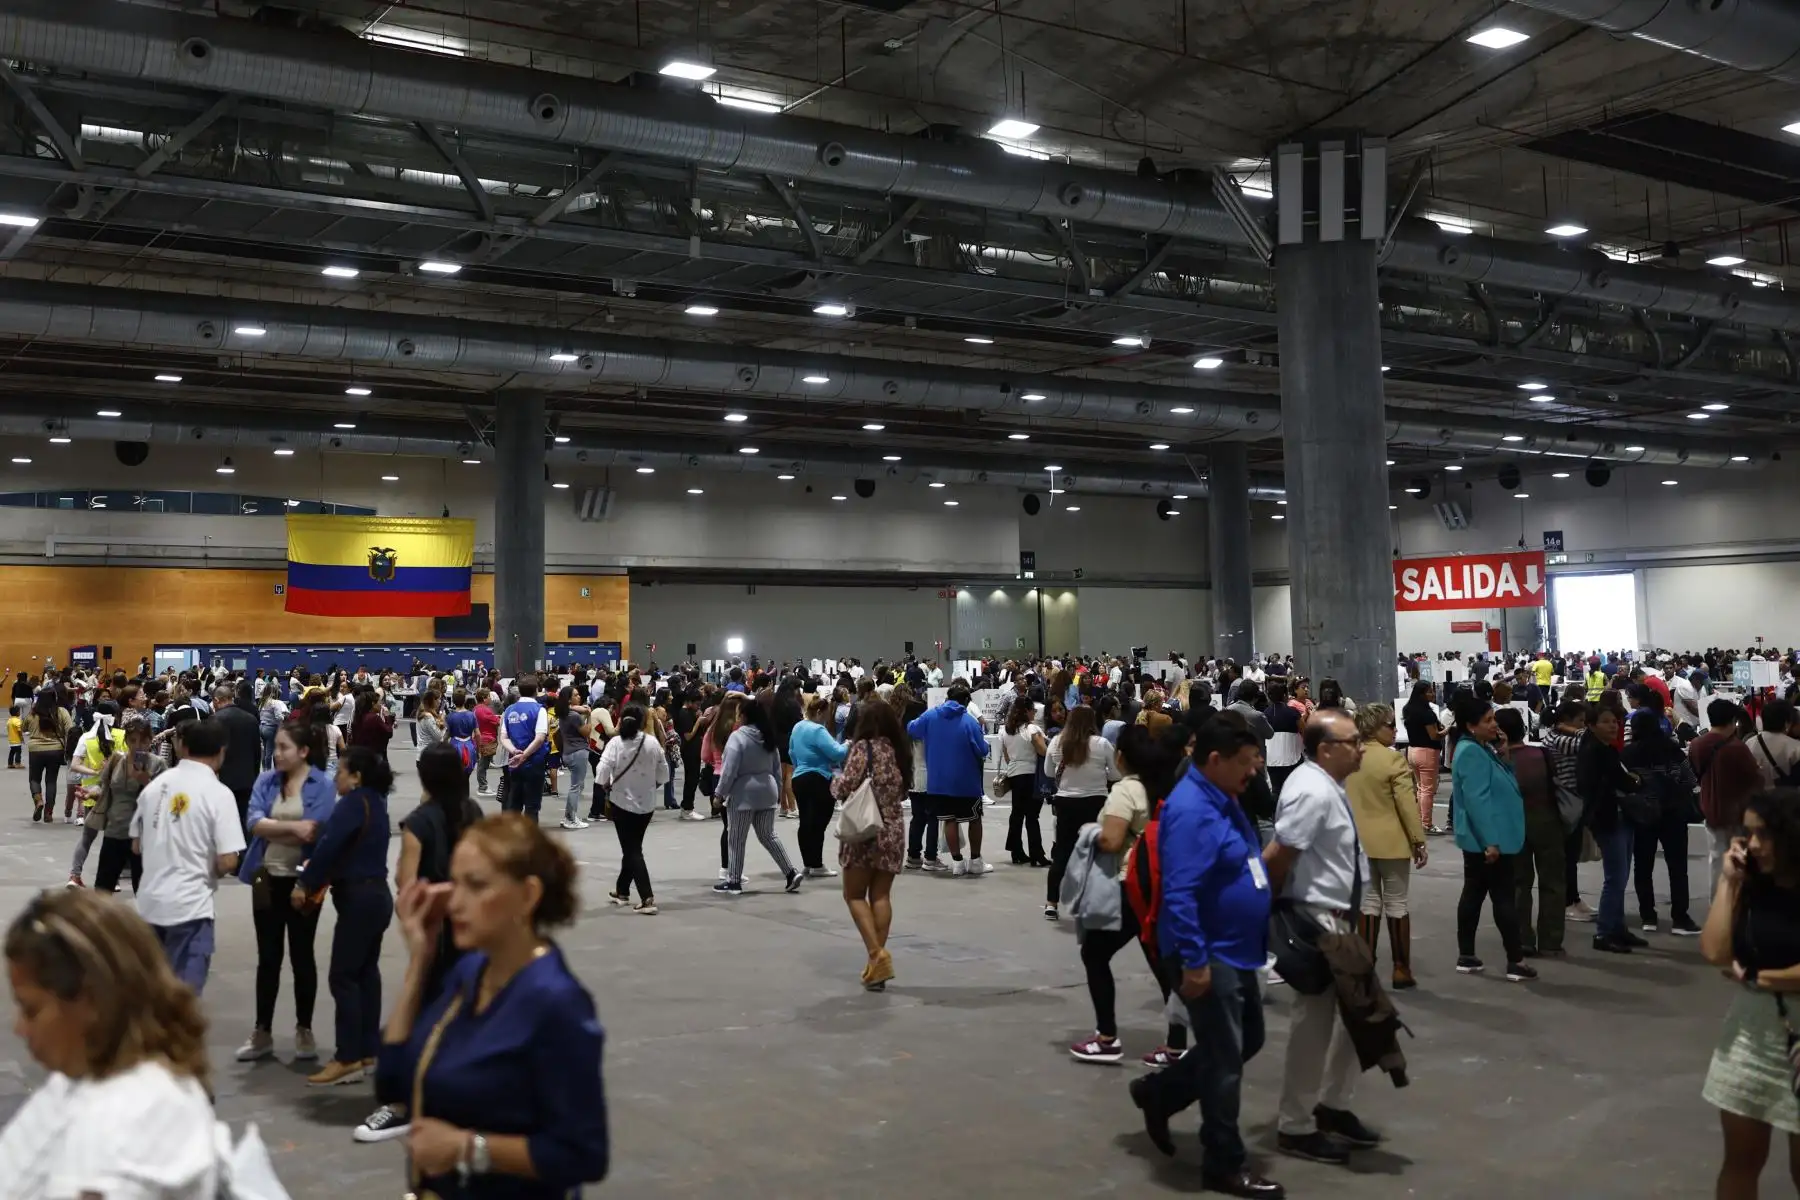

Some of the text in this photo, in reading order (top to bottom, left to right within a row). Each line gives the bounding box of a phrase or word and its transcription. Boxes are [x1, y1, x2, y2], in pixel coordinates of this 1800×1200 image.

[1402, 562, 1521, 602] SALIDA
[1421, 668, 1431, 677] 41
[1734, 670, 1750, 680] 40
